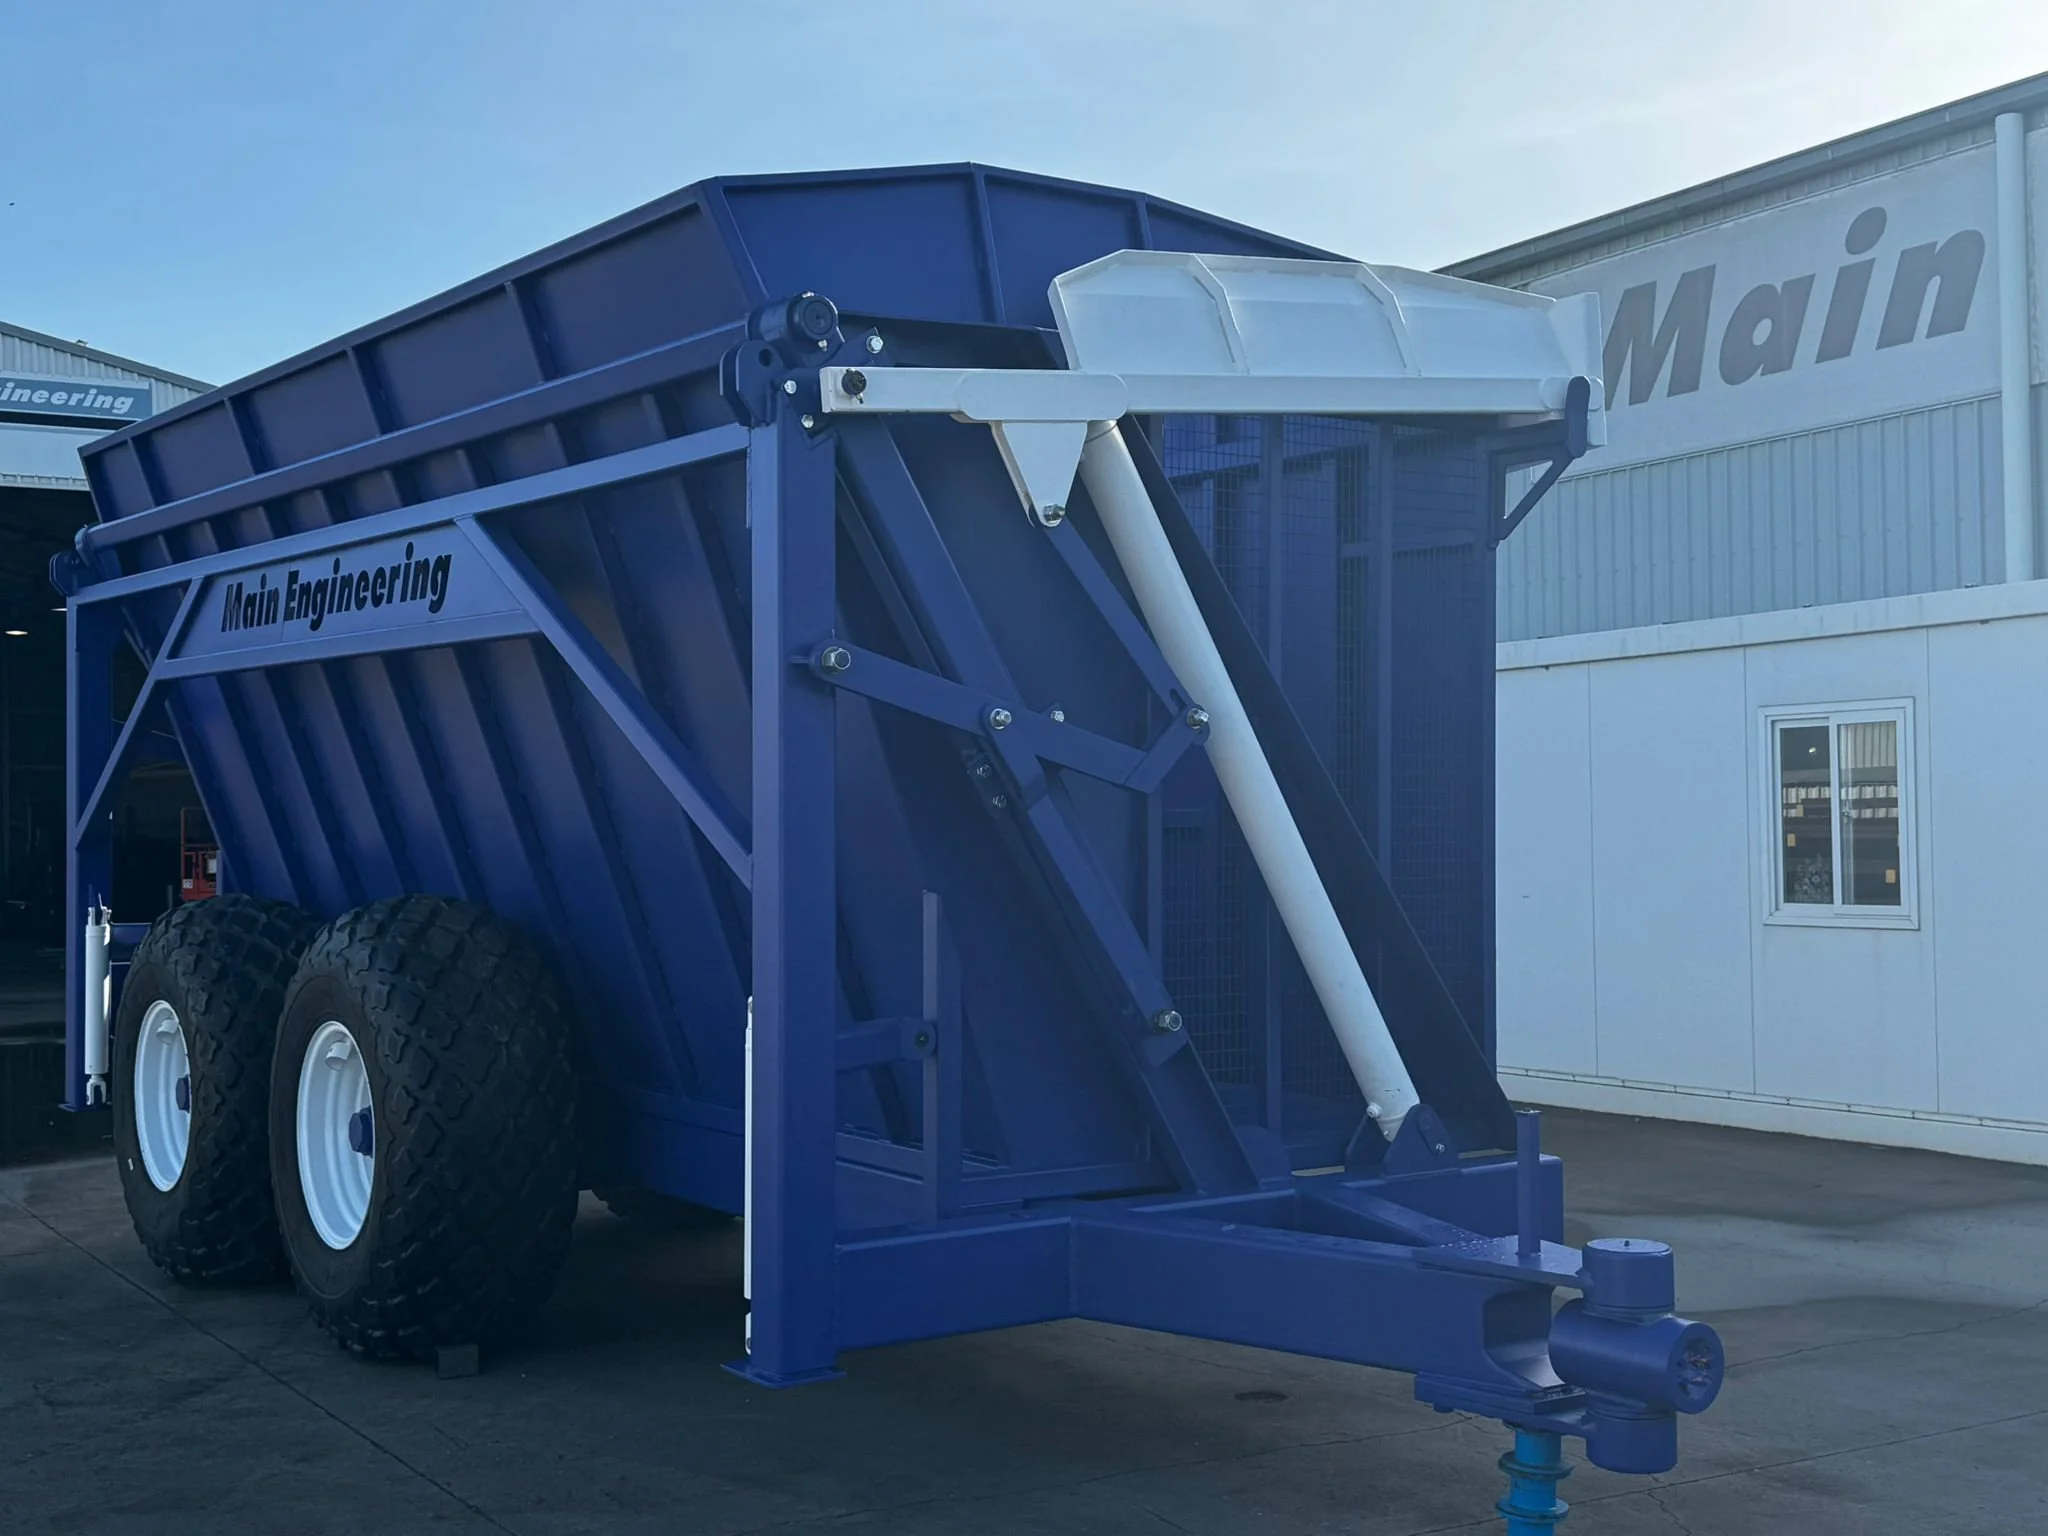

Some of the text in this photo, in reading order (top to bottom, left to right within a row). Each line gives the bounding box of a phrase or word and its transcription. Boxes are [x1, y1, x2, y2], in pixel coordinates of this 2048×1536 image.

[1602, 206, 1986, 412] Main
[0, 382, 134, 414] ineering
[221, 541, 452, 632] Main Engineering
